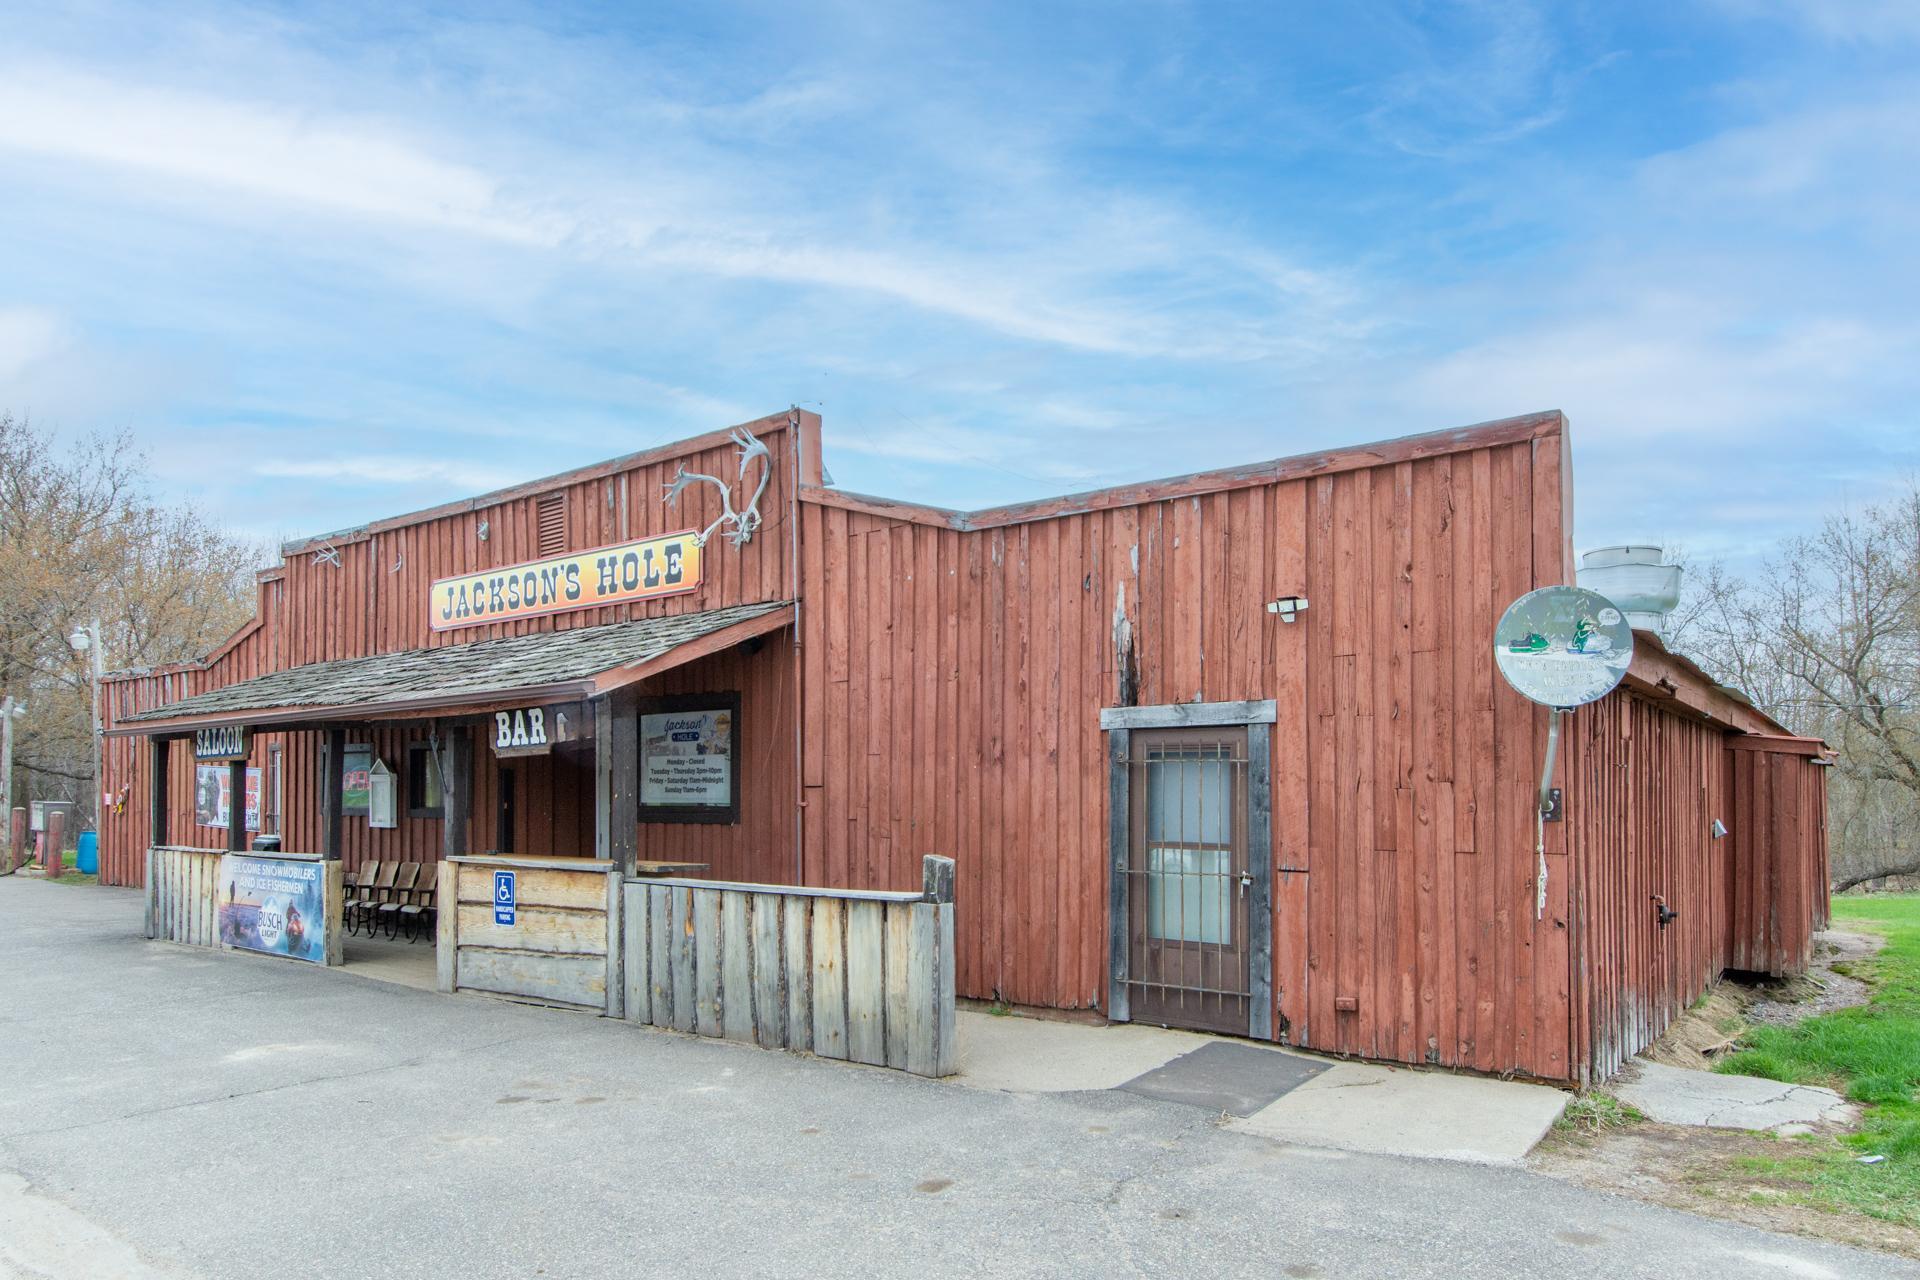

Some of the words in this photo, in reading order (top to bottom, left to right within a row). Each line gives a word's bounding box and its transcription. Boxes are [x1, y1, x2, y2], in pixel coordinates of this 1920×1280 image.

[442, 563, 580, 620] JACKSON'S
[597, 543, 682, 595] HOLE
[496, 708, 547, 748] BAR
[196, 725, 245, 756] SALOON
[666, 758, 685, 766] Monday
[674, 767, 695, 775] Thursday
[343, 771, 371, 791] OPEN
[649, 777, 664, 785] Friday
[668, 777, 688, 785] Saturday
[665, 786, 682, 794] Sunday
[262, 864, 316, 880] SNOWMOBILERS
[239, 877, 256, 889] AND
[257, 878, 267, 890] ICE
[267, 879, 304, 895] FISHERMEN
[258, 911, 283, 931] BUSCH
[261, 929, 277, 939] LIGHT
